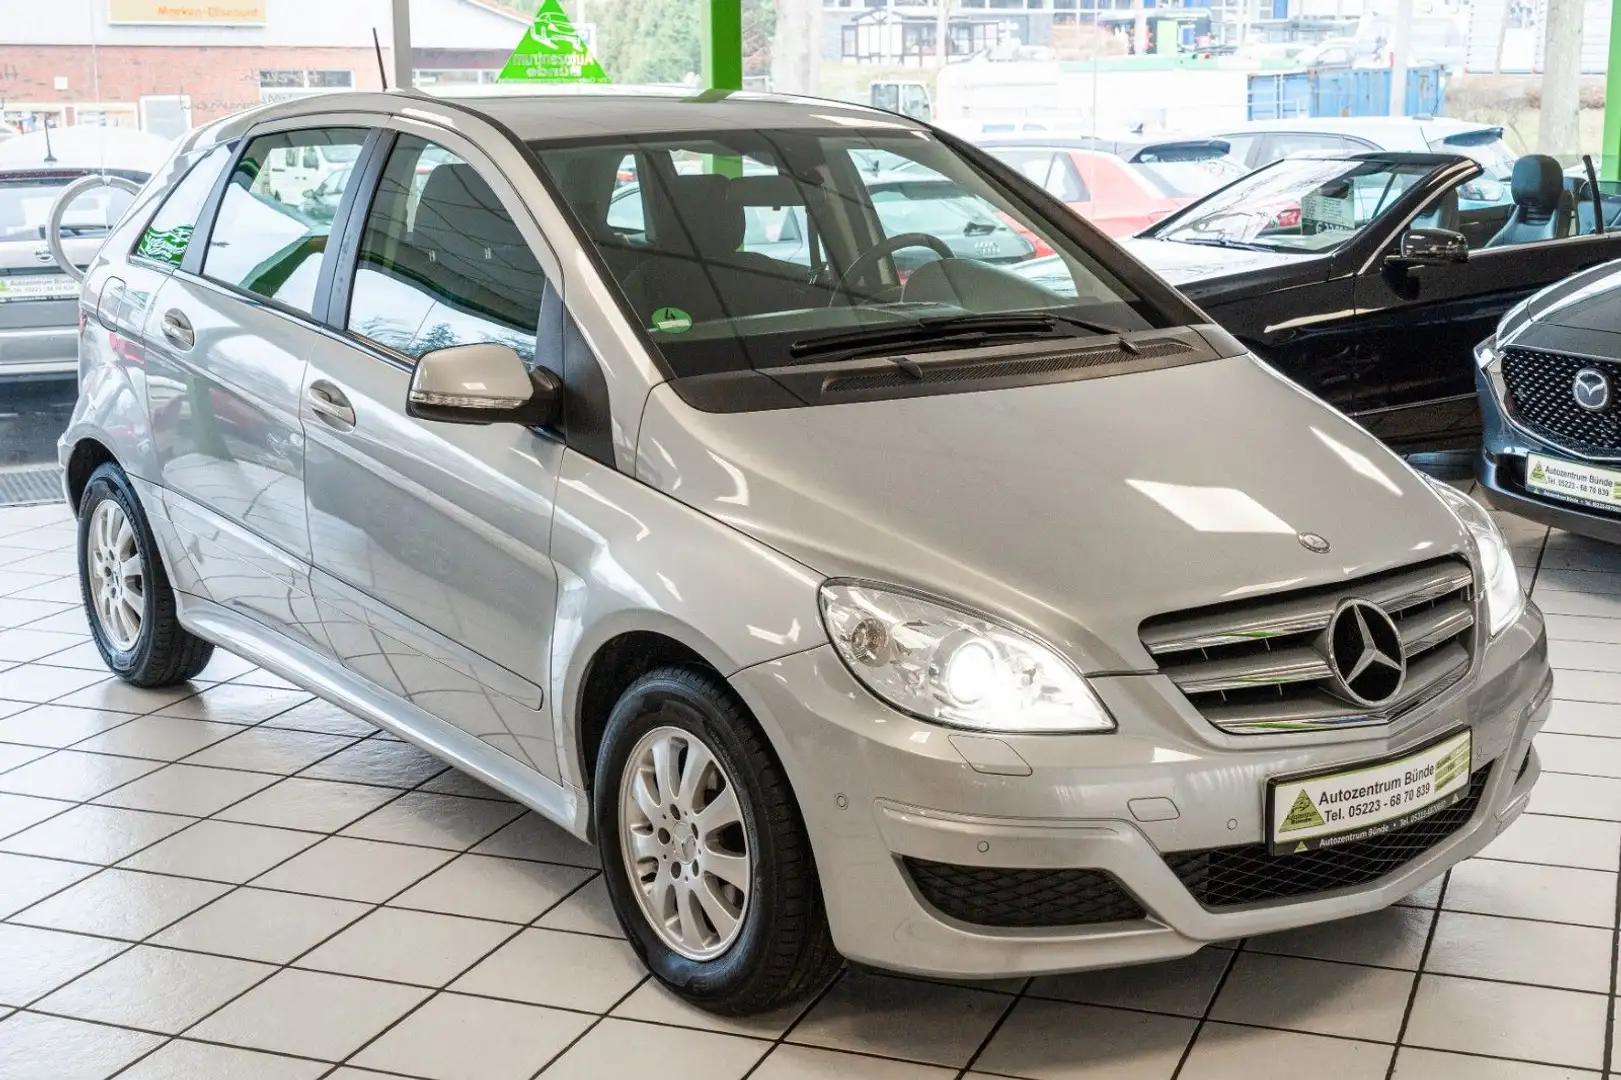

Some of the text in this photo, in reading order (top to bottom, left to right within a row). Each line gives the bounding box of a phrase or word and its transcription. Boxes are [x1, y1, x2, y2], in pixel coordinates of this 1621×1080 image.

[1545, 465, 1587, 481] Autozentrum
[1589, 475, 1613, 488] Bünde
[1319, 763, 1435, 806] Autozentrum Bünde
[1324, 807, 1345, 823] Tel.
[1348, 799, 1381, 818] 05223
[1390, 793, 1402, 807] 68
[1403, 788, 1415, 802] 70
[1416, 781, 1431, 799] 839
[1319, 831, 1368, 849] Autozentrum
[1368, 825, 1390, 838] Bünde
